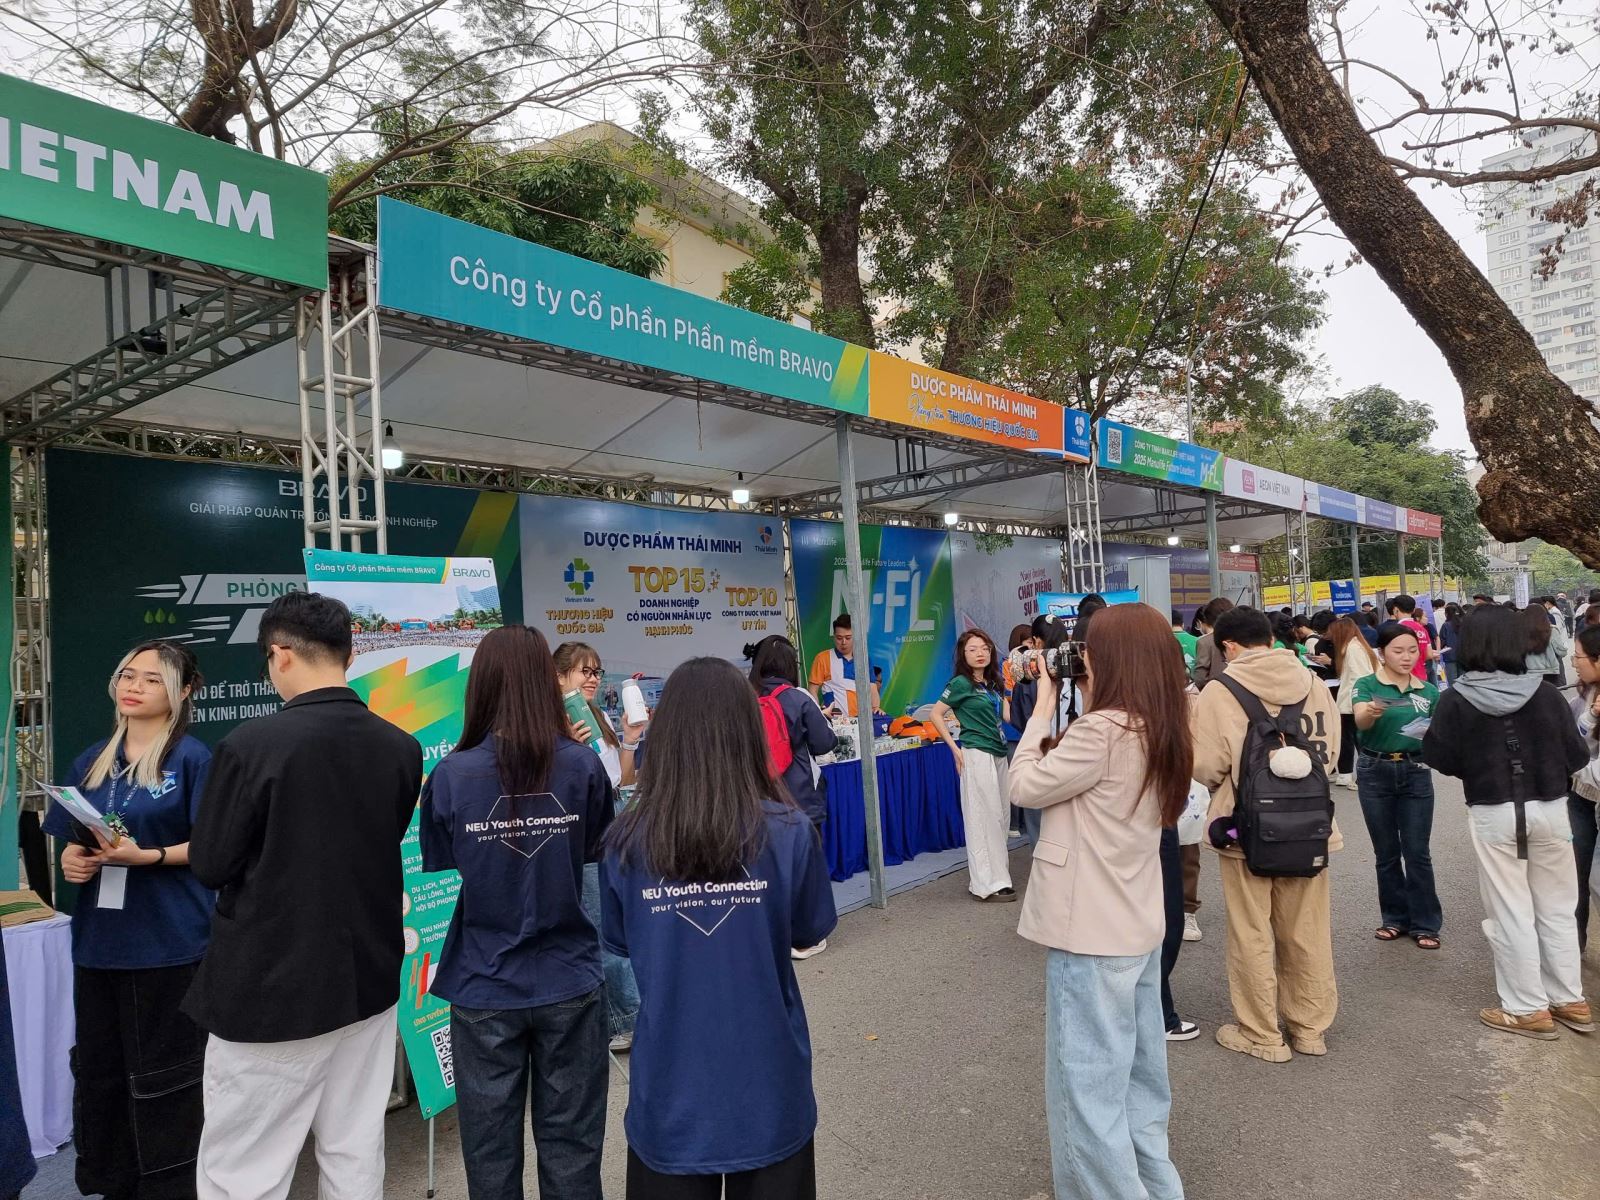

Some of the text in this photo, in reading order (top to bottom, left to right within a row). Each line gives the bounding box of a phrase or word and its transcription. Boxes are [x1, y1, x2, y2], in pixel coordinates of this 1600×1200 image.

[0, 117, 275, 241] IETNAM
[450, 256, 833, 383] Công ty Cổ phần Phần mềm BRAVO
[910, 372, 1038, 420] DƯỢC PHẨM THÁI MINH
[984, 416, 1003, 435] HIỆU
[1134, 453, 1147, 466] 2025
[1259, 479, 1272, 492] AEON
[189, 501, 215, 514] GIẢI
[218, 503, 251, 517] PHÁP
[254, 506, 289, 519] QUẢN
[402, 517, 438, 530] NGHIỆP
[584, 531, 742, 554] DƯỢC PHẨM THÁI MINH
[314, 562, 436, 575] Công ty Cổ phần Phần mềm BRAVO
[453, 568, 491, 578] BRAVO
[639, 596, 700, 610] DOANH NGHIỆP
[545, 605, 614, 622] THƯƠNG HIỆU
[626, 609, 712, 623] CÓ NGUỒN NHÂN LỰC
[721, 609, 737, 617] CÔNG
[759, 609, 769, 617] VIỆT
[770, 609, 782, 617] NAM
[556, 621, 605, 635] QUỐC GIA
[645, 623, 693, 638] HẠNH PHÚC
[742, 618, 767, 630] UY TÍN
[210, 680, 226, 699] ĐỂ
[228, 680, 251, 698] TRỞ
[208, 705, 237, 722] KINH
[239, 702, 277, 719] DOANH
[466, 821, 489, 833] NEU
[491, 817, 525, 831] Youth
[477, 833, 498, 843] your
[500, 830, 529, 840] vision,
[531, 828, 547, 836] our
[411, 885, 421, 894] DU
[642, 878, 768, 901] NEU Youth Connection
[651, 896, 761, 914] your vision, our future
